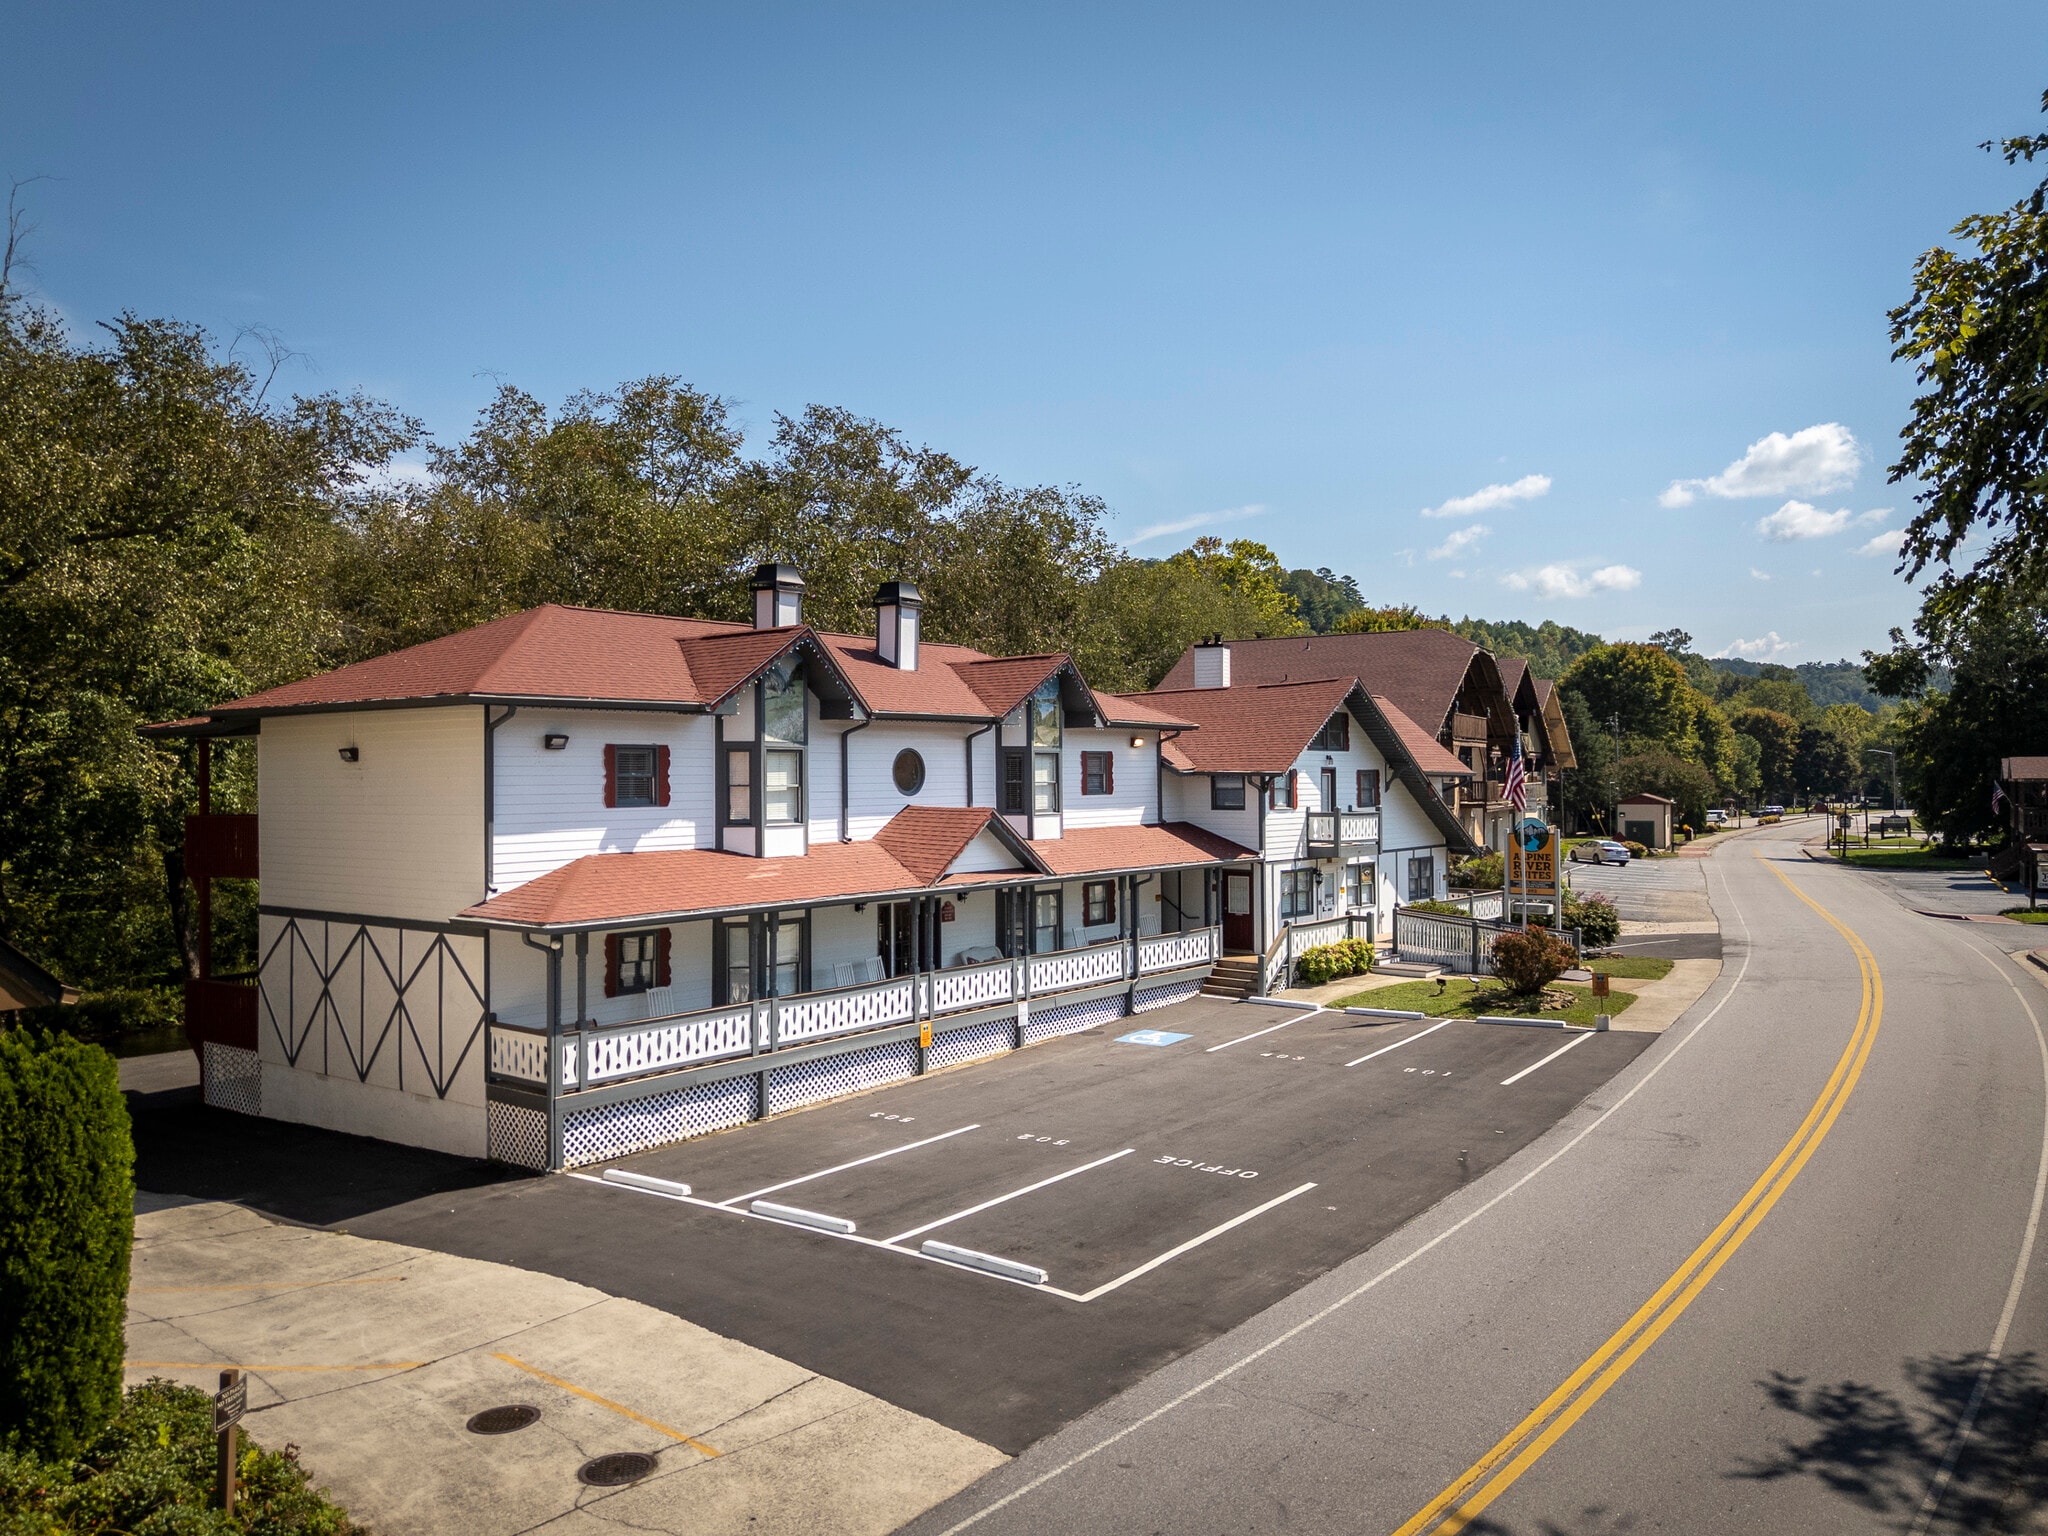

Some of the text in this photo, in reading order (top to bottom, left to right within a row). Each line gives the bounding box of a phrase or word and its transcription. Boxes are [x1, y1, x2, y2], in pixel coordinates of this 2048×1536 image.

[1513, 853, 1551, 861] APINE
[1513, 861, 1551, 870] RVER
[1152, 1155, 1259, 1179] OFFICE
